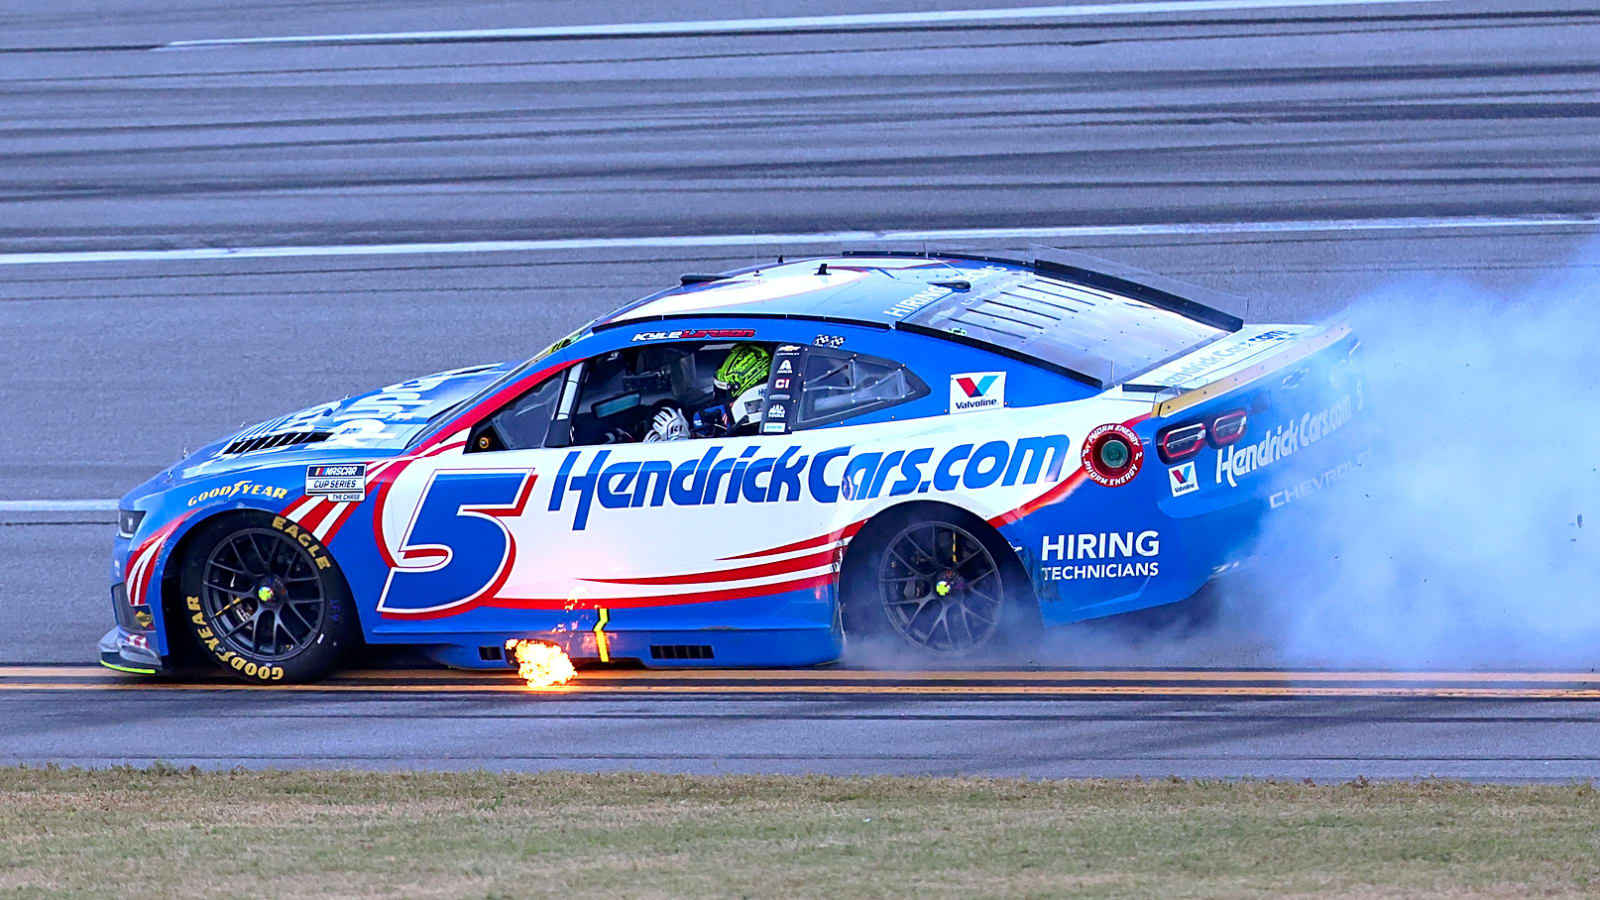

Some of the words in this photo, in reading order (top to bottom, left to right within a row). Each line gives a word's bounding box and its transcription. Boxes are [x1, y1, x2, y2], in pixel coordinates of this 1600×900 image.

[883, 285, 953, 318] HIRING
[631, 331, 683, 342] KYLE
[955, 399, 998, 410] Valvoline
[1115, 424, 1141, 447] ENERGY
[313, 479, 330, 489] CUP
[330, 479, 357, 489] SERIES
[324, 466, 358, 476] NASCAR
[547, 434, 1070, 531] HendrickCars.com
[1084, 460, 1109, 485] PHORM
[1109, 463, 1138, 486] ENERGY
[187, 480, 288, 507] GOODYEAR
[272, 515, 331, 570] EAGLE
[376, 467, 537, 618] 5
[1041, 530, 1160, 561] HIRING
[1041, 561, 1159, 581] TECHNICIANS
[186, 595, 284, 681] GOODYEAR
